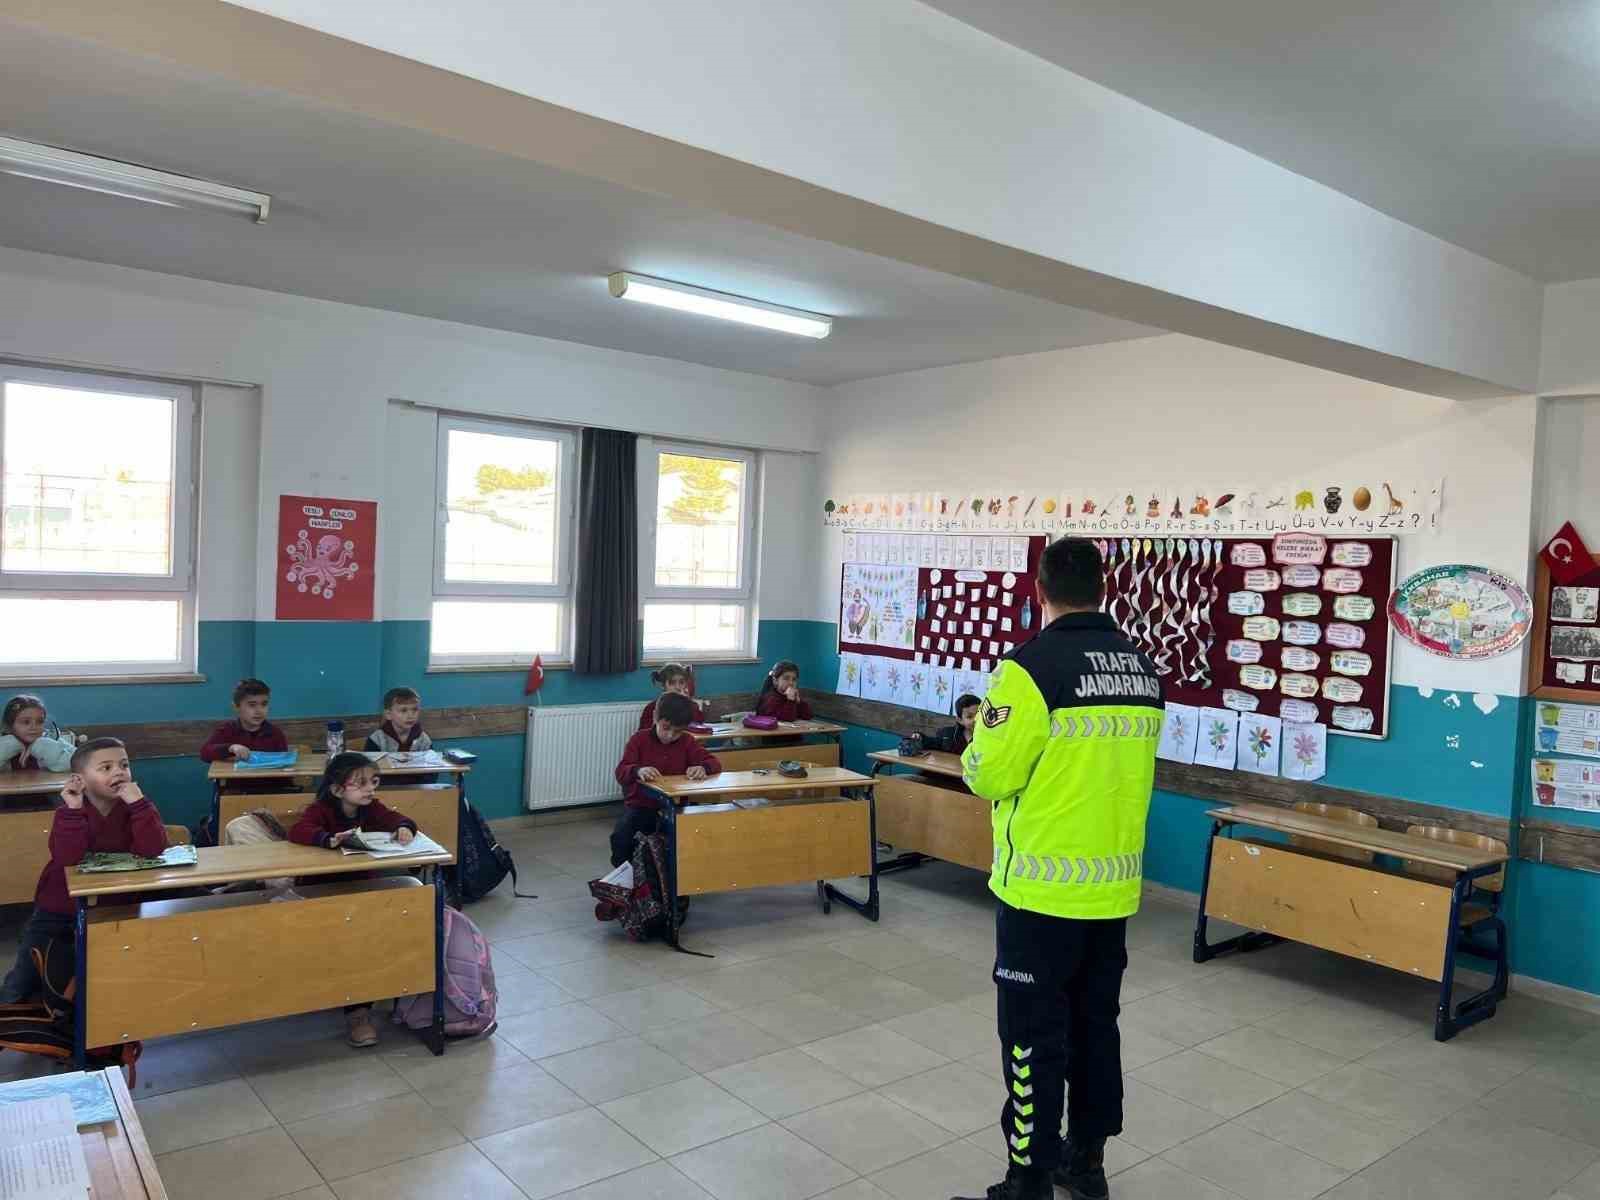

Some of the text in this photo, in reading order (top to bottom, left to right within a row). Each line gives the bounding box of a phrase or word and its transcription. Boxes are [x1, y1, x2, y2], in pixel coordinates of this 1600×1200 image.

[1083, 651, 1145, 673] TRAFİK
[1074, 673, 1160, 700] JANDARMASI
[995, 967, 1035, 985] JANDARMA
